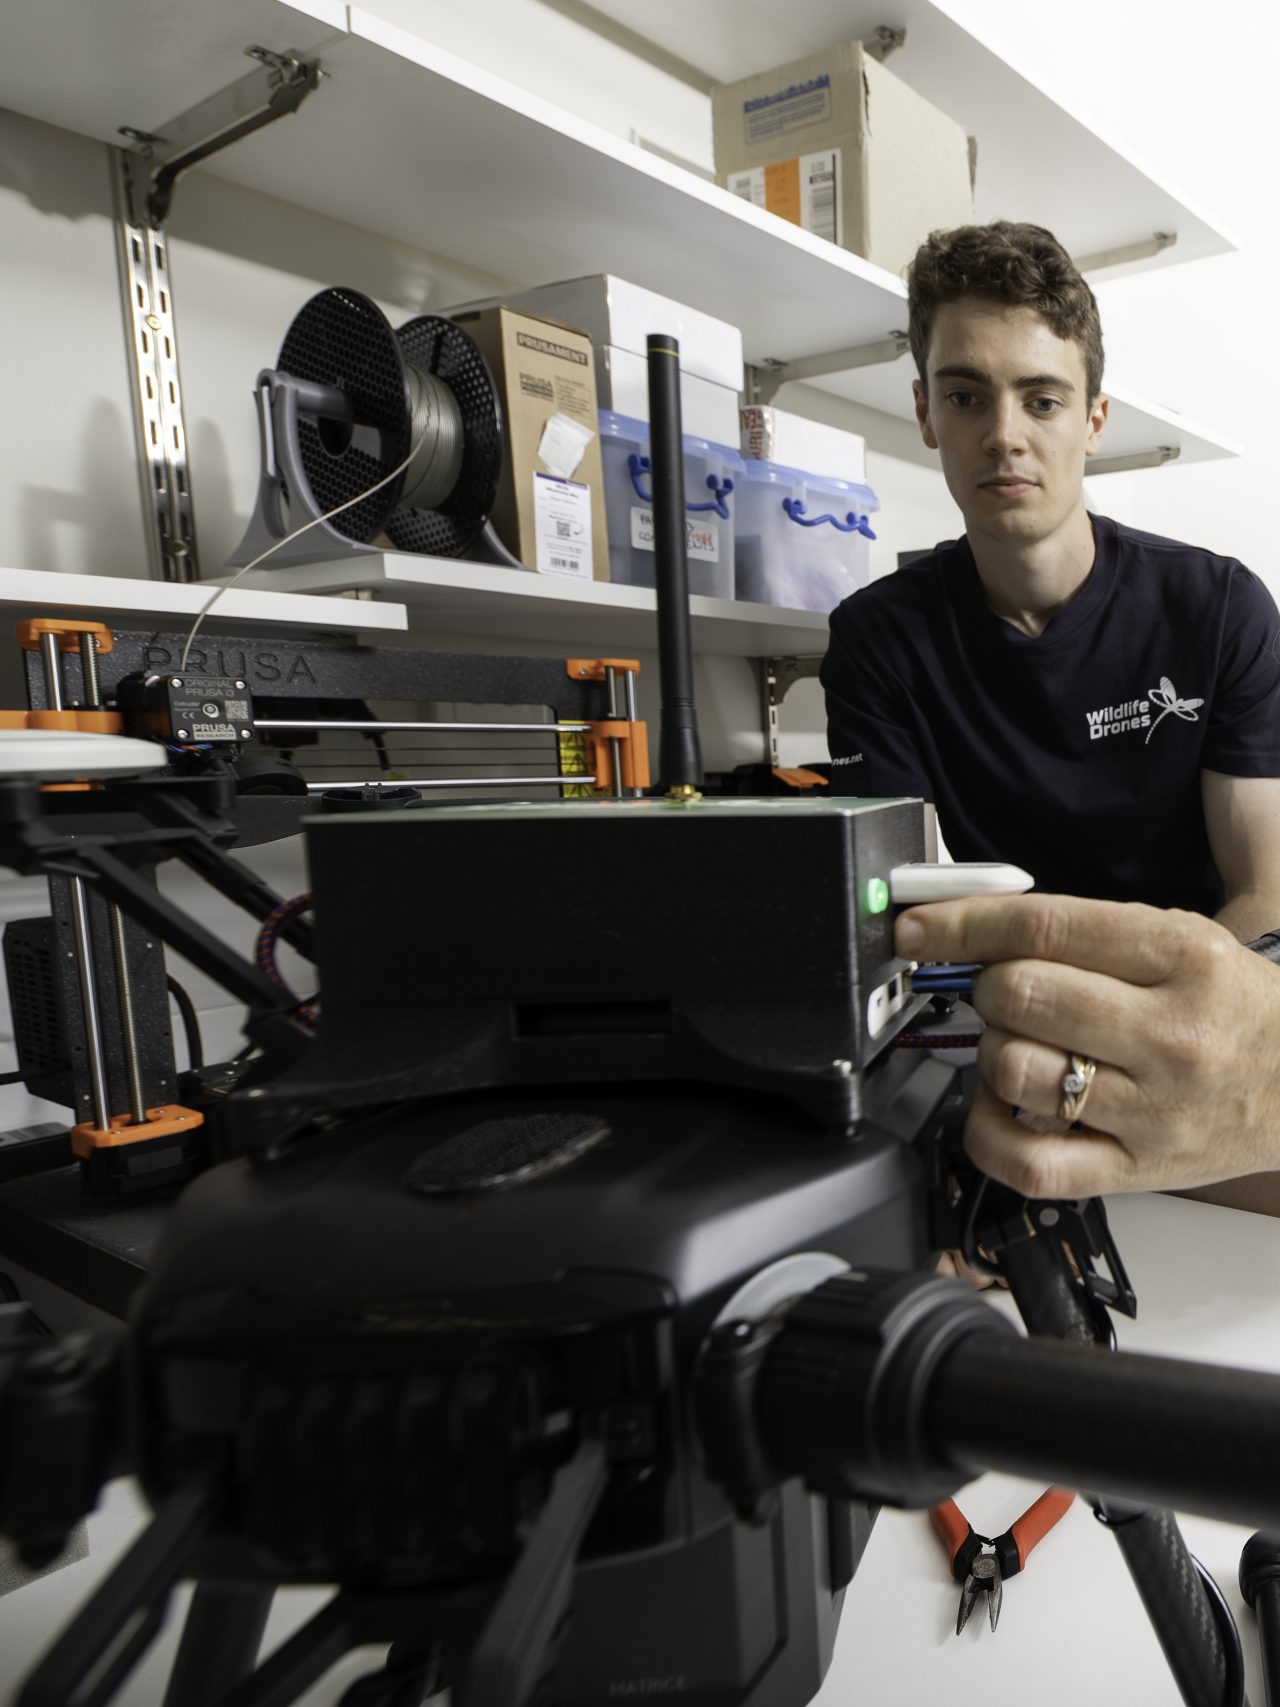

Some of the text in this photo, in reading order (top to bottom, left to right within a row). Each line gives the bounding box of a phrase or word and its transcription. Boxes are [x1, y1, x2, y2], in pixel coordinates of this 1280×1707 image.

[517, 332, 588, 366] PRUSAMENT
[142, 646, 317, 684] PRUSA
[184, 679, 233, 688] ORIGINAL
[185, 688, 224, 697] PRUSA
[1086, 699, 1150, 726] Wildlife
[192, 723, 235, 732] PRUSA
[1089, 714, 1152, 740] Drones
